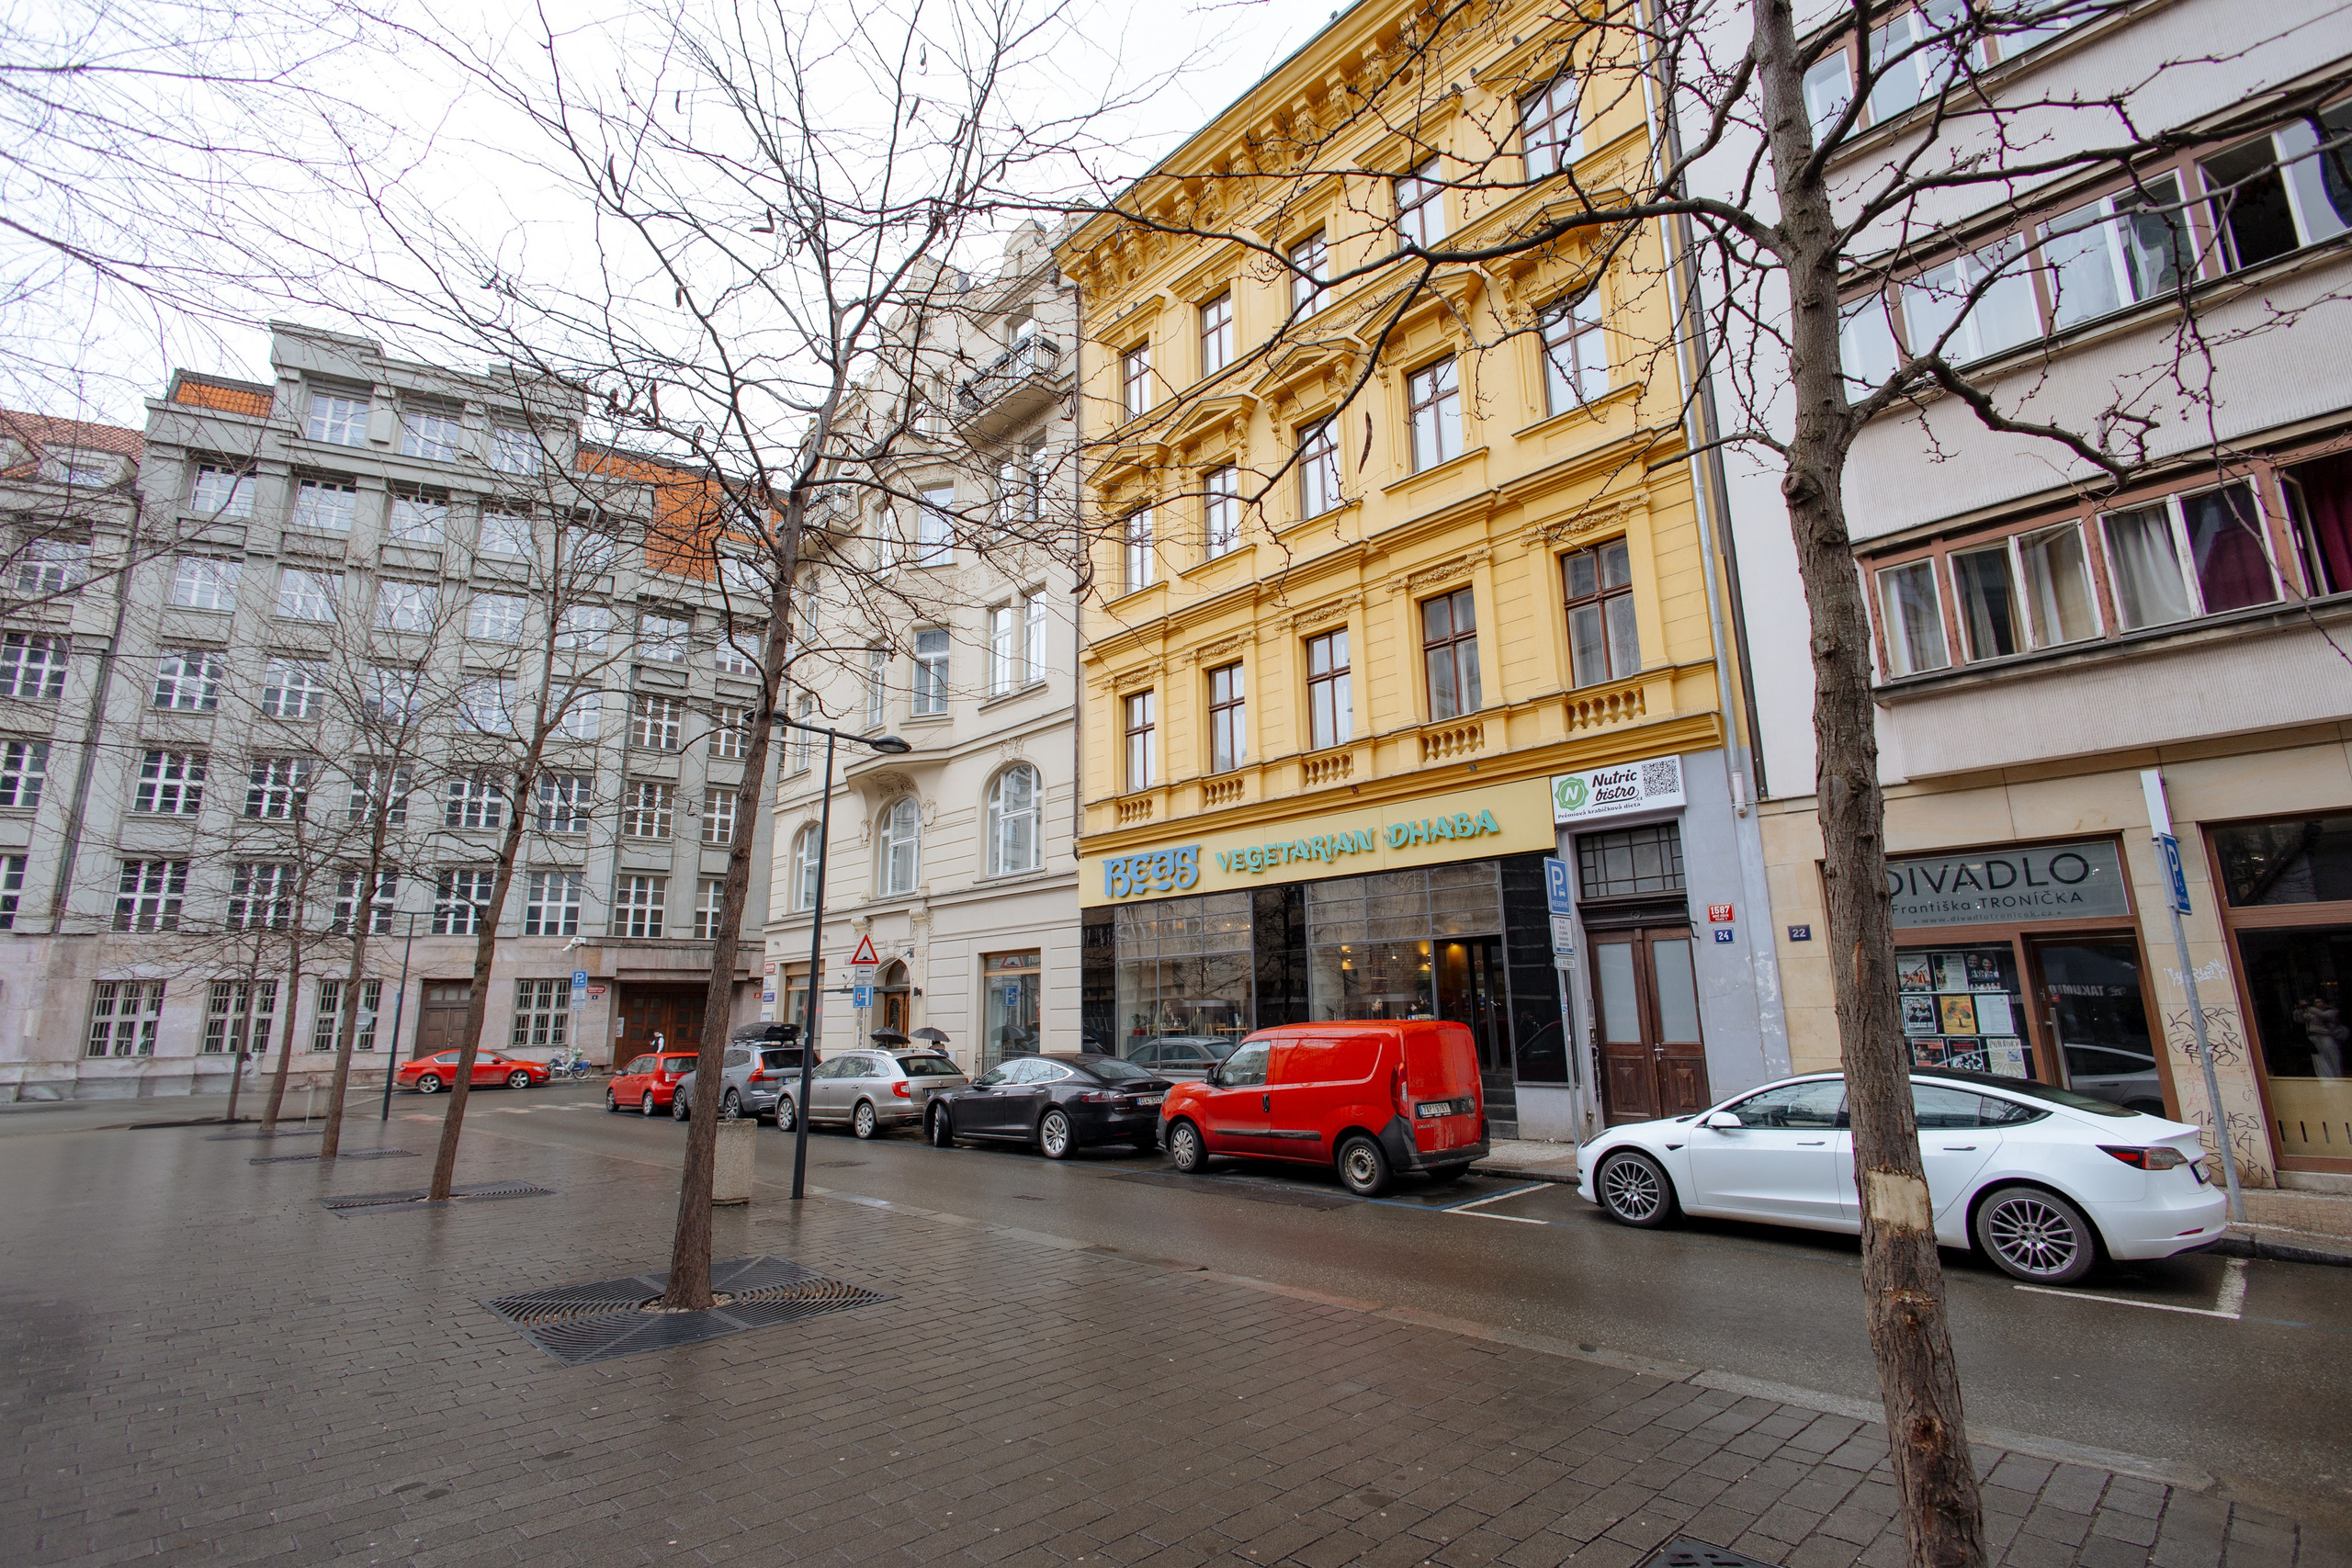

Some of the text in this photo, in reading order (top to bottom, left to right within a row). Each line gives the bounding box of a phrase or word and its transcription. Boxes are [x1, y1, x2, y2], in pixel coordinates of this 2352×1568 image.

[1592, 769, 1638, 788] Nutric
[1595, 785, 1640, 802] bistro
[1557, 801, 1642, 819] Prémiová krabičková dieta
[1216, 828, 1374, 874] VEGETARIAN
[1384, 808, 1499, 848] DHABA
[2165, 844, 2179, 888] P
[1551, 865, 1564, 897] P
[1711, 905, 1730, 915] 1587
[1891, 890, 2084, 915] Františka TRONÍČKA
[1718, 931, 1730, 941] 24
[1792, 928, 1806, 938] 22
[575, 973, 584, 984] P
